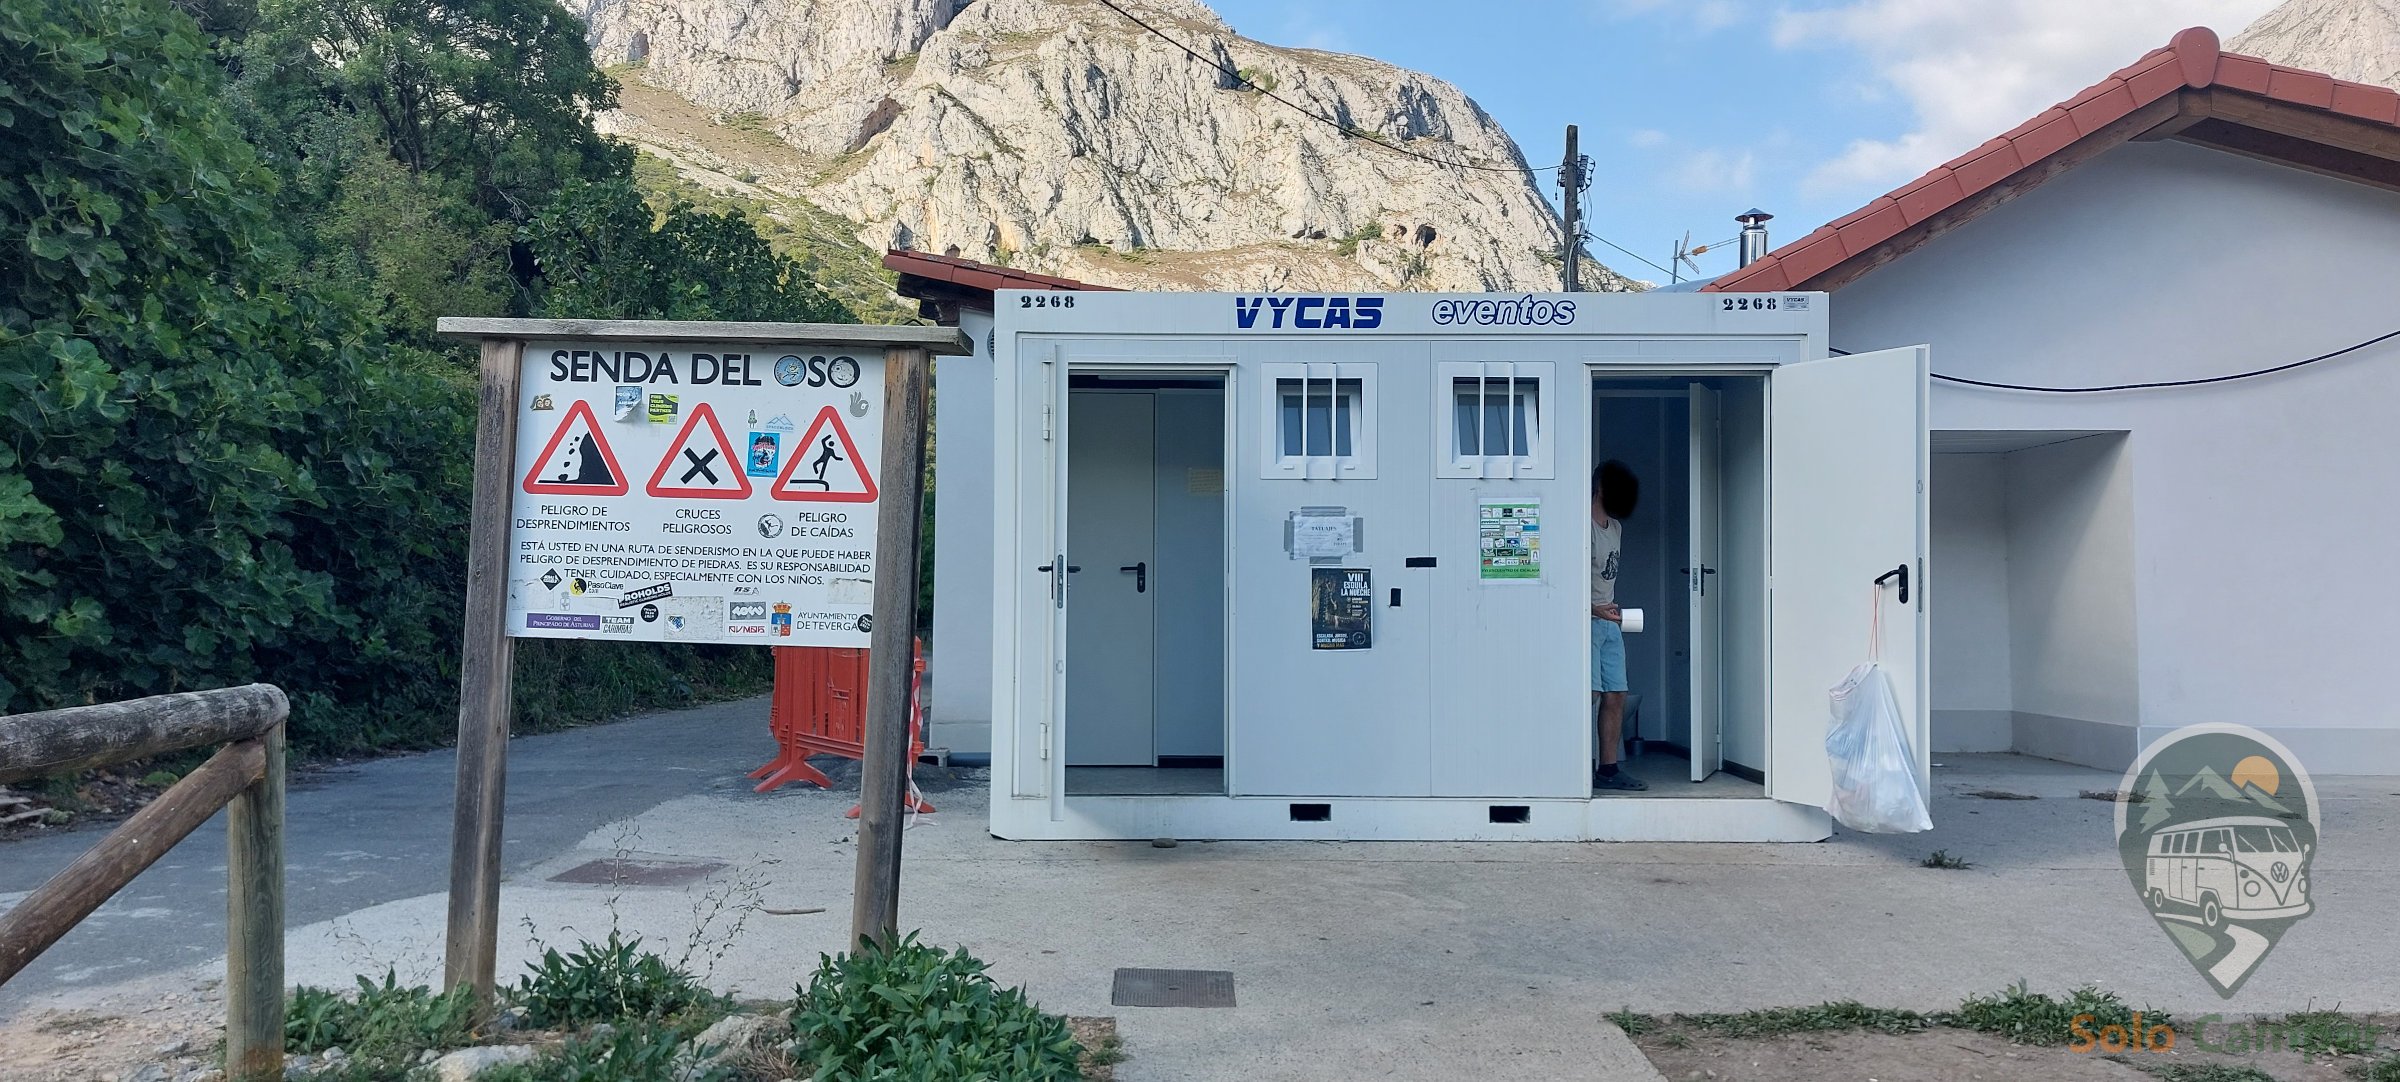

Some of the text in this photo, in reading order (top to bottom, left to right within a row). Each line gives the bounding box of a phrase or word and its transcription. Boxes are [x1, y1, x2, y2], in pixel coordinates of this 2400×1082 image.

[1021, 295, 1075, 308] 2268
[1723, 298, 1777, 311] 2268
[1236, 297, 1385, 329] VYCAS
[1432, 294, 1576, 326] eventos
[550, 350, 678, 384] SENDA
[690, 353, 762, 386] DEL
[541, 505, 608, 516] PELIGRO DE
[675, 509, 721, 519] CRUCES
[799, 512, 847, 523] PELIGRO
[516, 519, 630, 531] DESPRENDIMIENTOS
[662, 523, 732, 534] PELIGROSOS
[791, 525, 854, 538] DE CAÍDAS
[520, 540, 871, 560] ESTÁ USTED EN UNA RUTA DE SENDERISMO EN LA QUE PUEDE HABER
[520, 554, 871, 573] PELIGRO DE DESPRENDIMIENTO DE PIEDRAS. ES SU RESPONSABILIDAD
[564, 568, 825, 585] TENER CUIDADO, ESPECIALMENTE CON LOS NIÑOS.
[1347, 573, 1364, 581] VIII
[587, 581, 623, 590] PasoClave
[1341, 588, 1349, 596] LA
[797, 612, 857, 620] AYUNTAMIENTO
[796, 621, 810, 630] DE
[813, 621, 859, 631] TEVERGA
